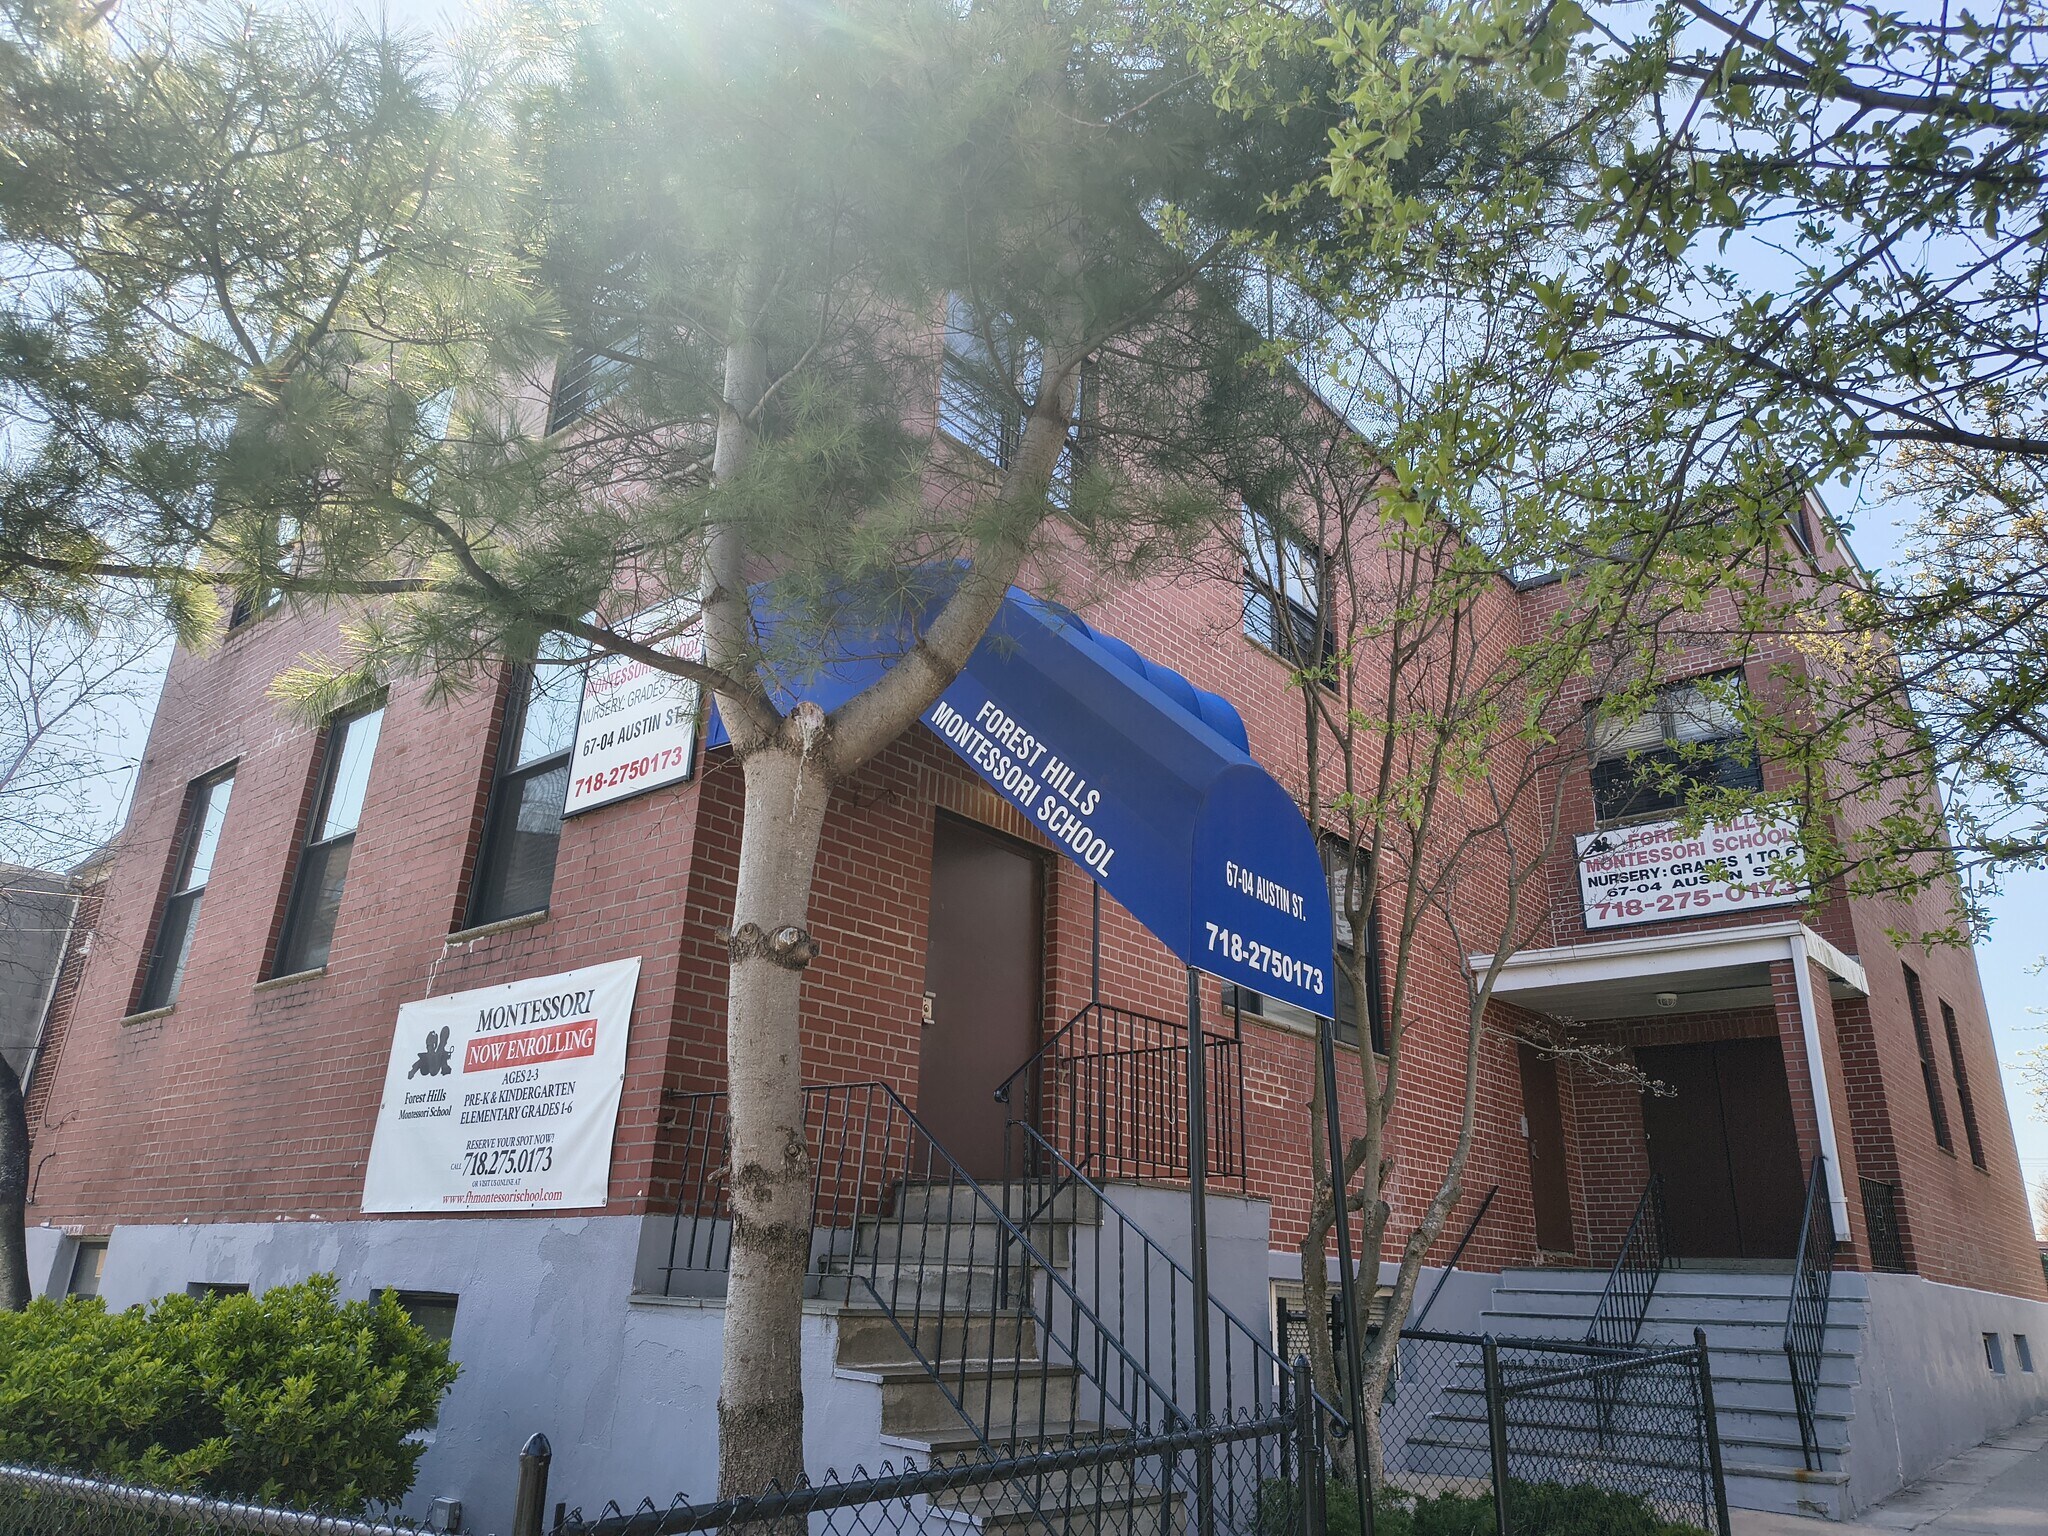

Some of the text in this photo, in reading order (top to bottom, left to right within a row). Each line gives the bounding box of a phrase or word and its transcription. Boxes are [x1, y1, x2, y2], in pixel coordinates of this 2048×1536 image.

[627, 678, 666, 707] GRADES
[583, 735, 614, 757] 67-04
[617, 713, 661, 745] AUSTIN
[575, 746, 683, 798] 718-2750173
[975, 700, 1100, 816] FOREST HILLS
[930, 700, 1115, 878] MONTESSORI SCHOOL
[1586, 828, 1793, 873] MONTESSORI SCHOOL
[1627, 824, 1701, 848] FORE
[1745, 853, 1753, 864] 1
[1756, 849, 1780, 863] TO
[1226, 860, 1307, 922] 67-04 AUSTIN ST.
[1607, 882, 1662, 897] 67-04
[1672, 870, 1743, 889] AUSN
[1595, 879, 1798, 920] 718-275-0173
[1206, 921, 1324, 995] 718-2750173
[475, 989, 596, 1033] MONTESSORI
[468, 1027, 594, 1066] NOW ENROLLING
[502, 1069, 539, 1085] AGES 2-3
[404, 1089, 447, 1104] Forest Hills
[464, 1081, 577, 1107] PRE-K & KINDERGARTEN
[398, 1105, 453, 1120] Montessori School
[460, 1101, 574, 1124] ELEMENTARY GRADES 1-6
[466, 1138, 496, 1150] RESERVE
[496, 1136, 515, 1148] YOUR
[515, 1135, 534, 1146] SPOT
[462, 1146, 553, 1176] 718.275.0173
[442, 1188, 563, 1204] www.fhmontessorischool.com
